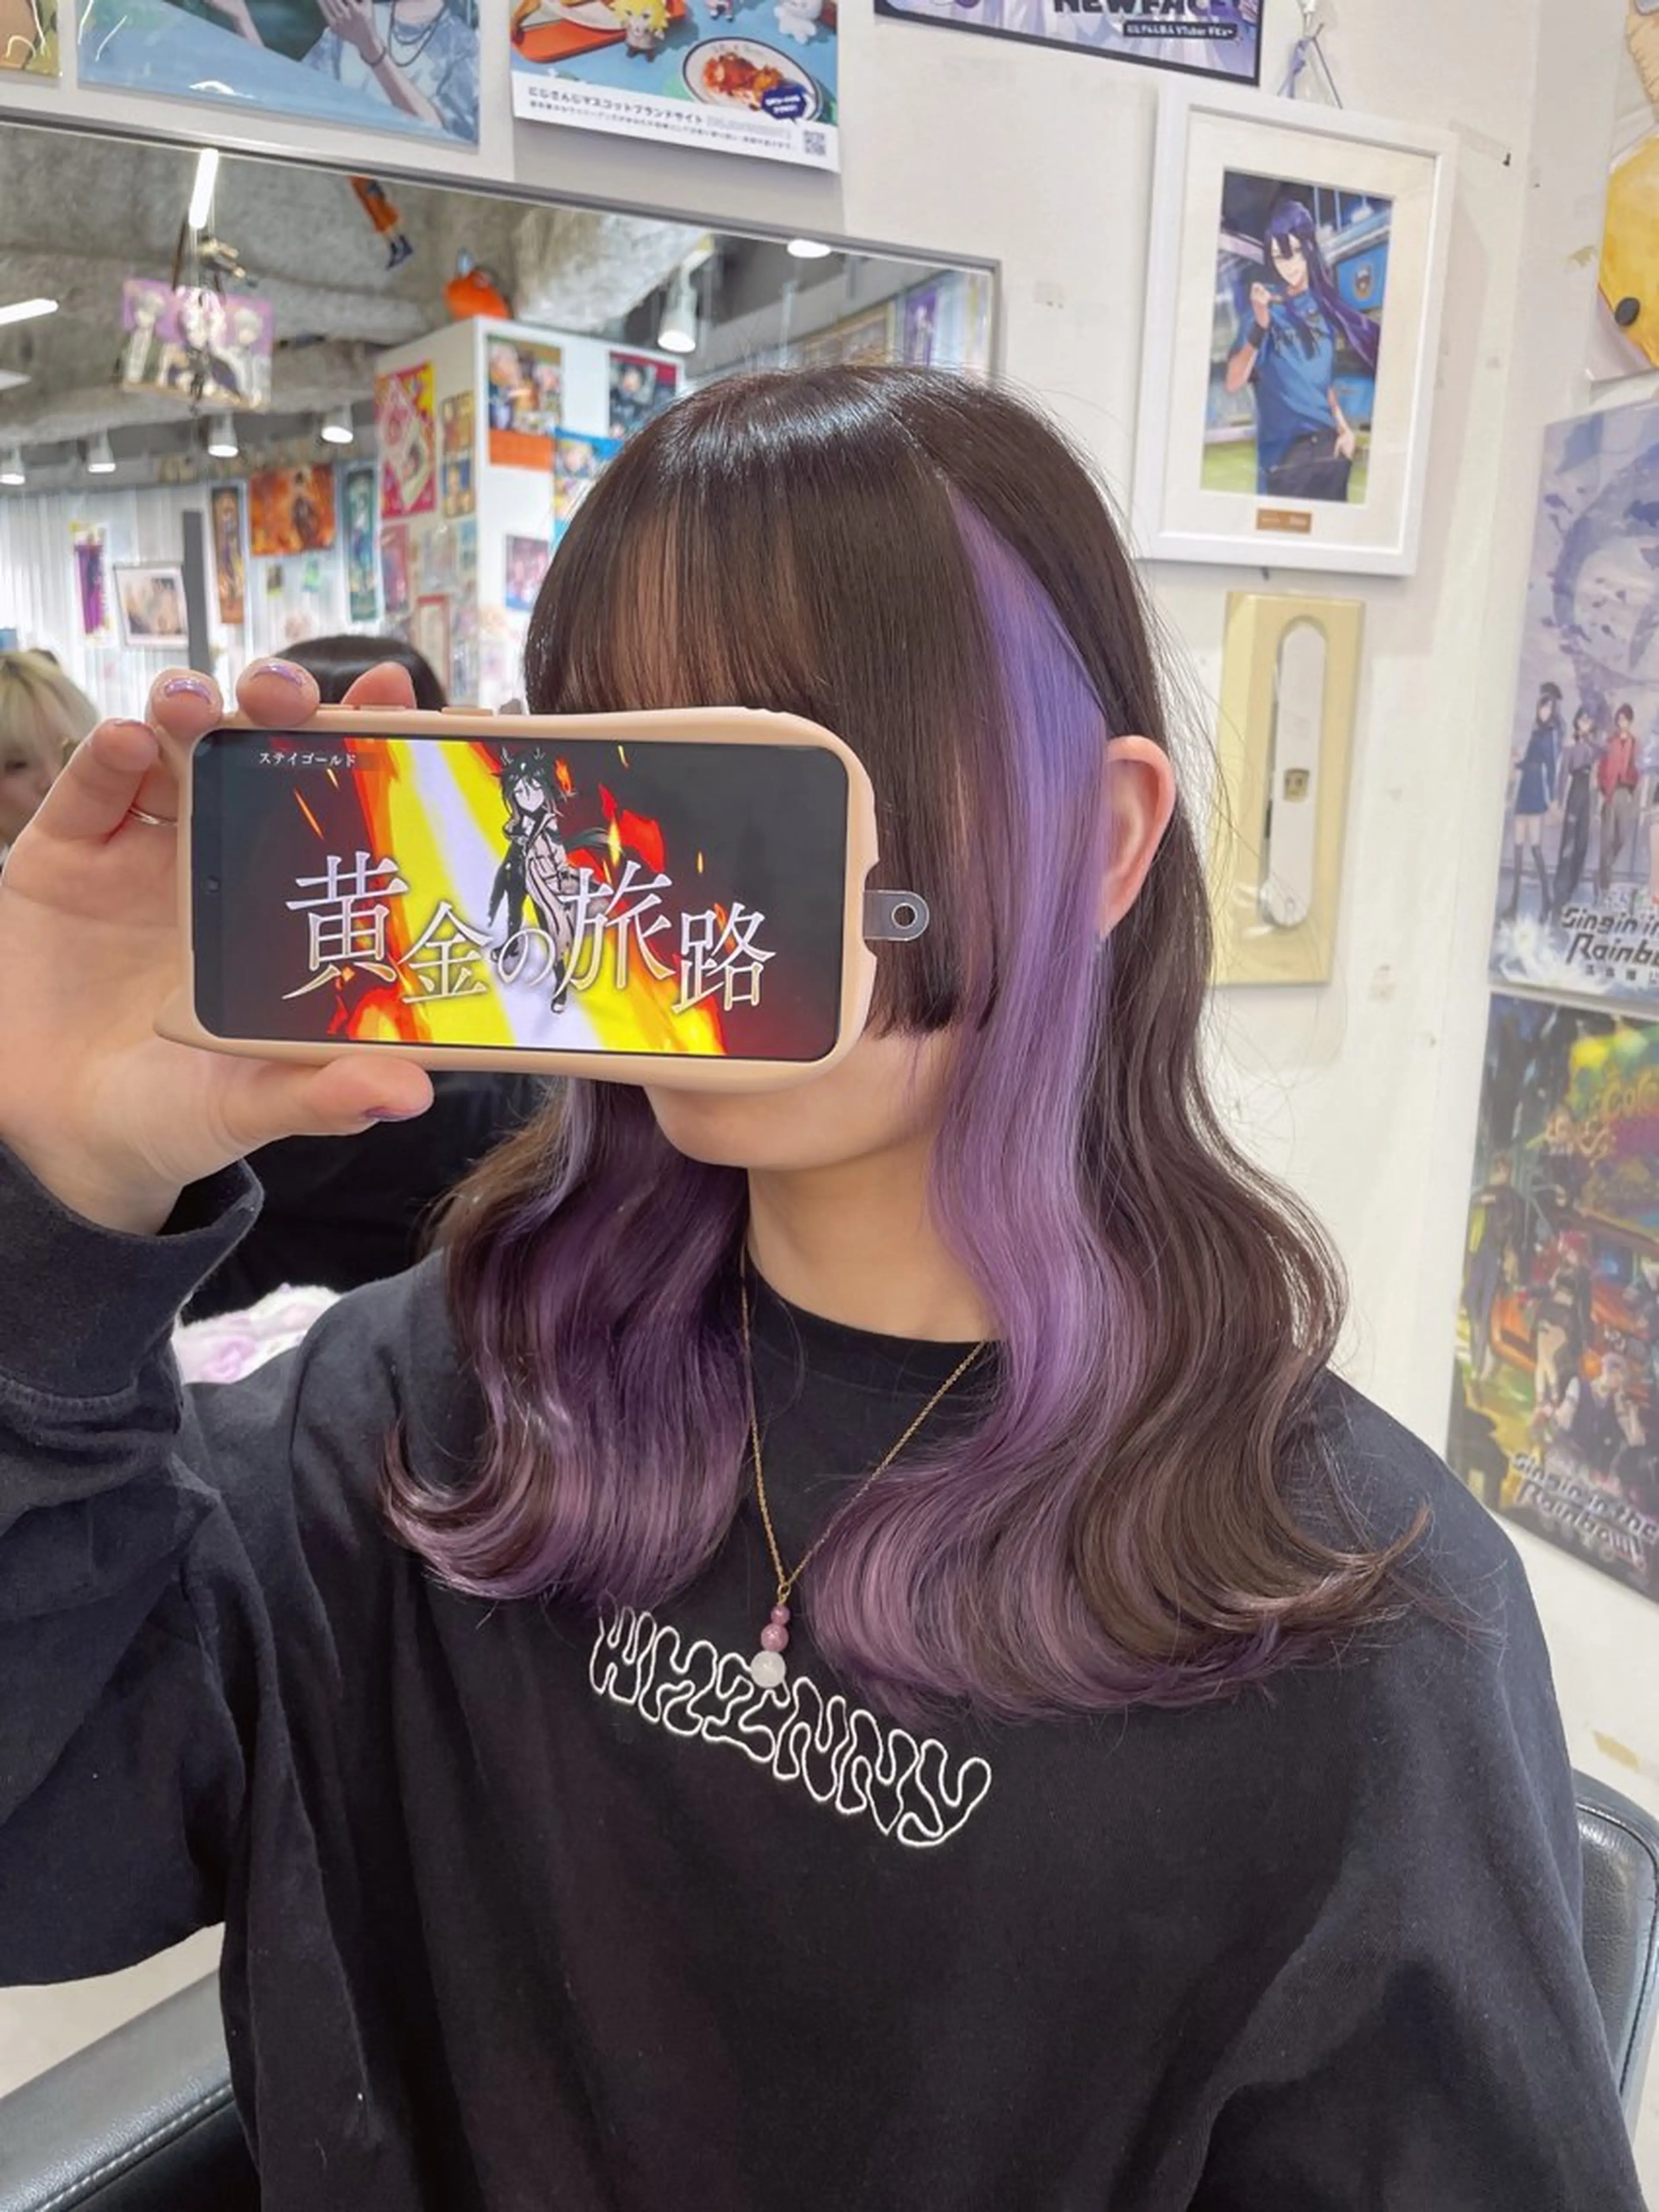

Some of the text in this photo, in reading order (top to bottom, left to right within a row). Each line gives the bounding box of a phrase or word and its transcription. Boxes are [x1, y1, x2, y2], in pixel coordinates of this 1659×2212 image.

[259, 752, 356, 767] ステイゴールド
[282, 851, 776, 1014] 黄金の旅路
